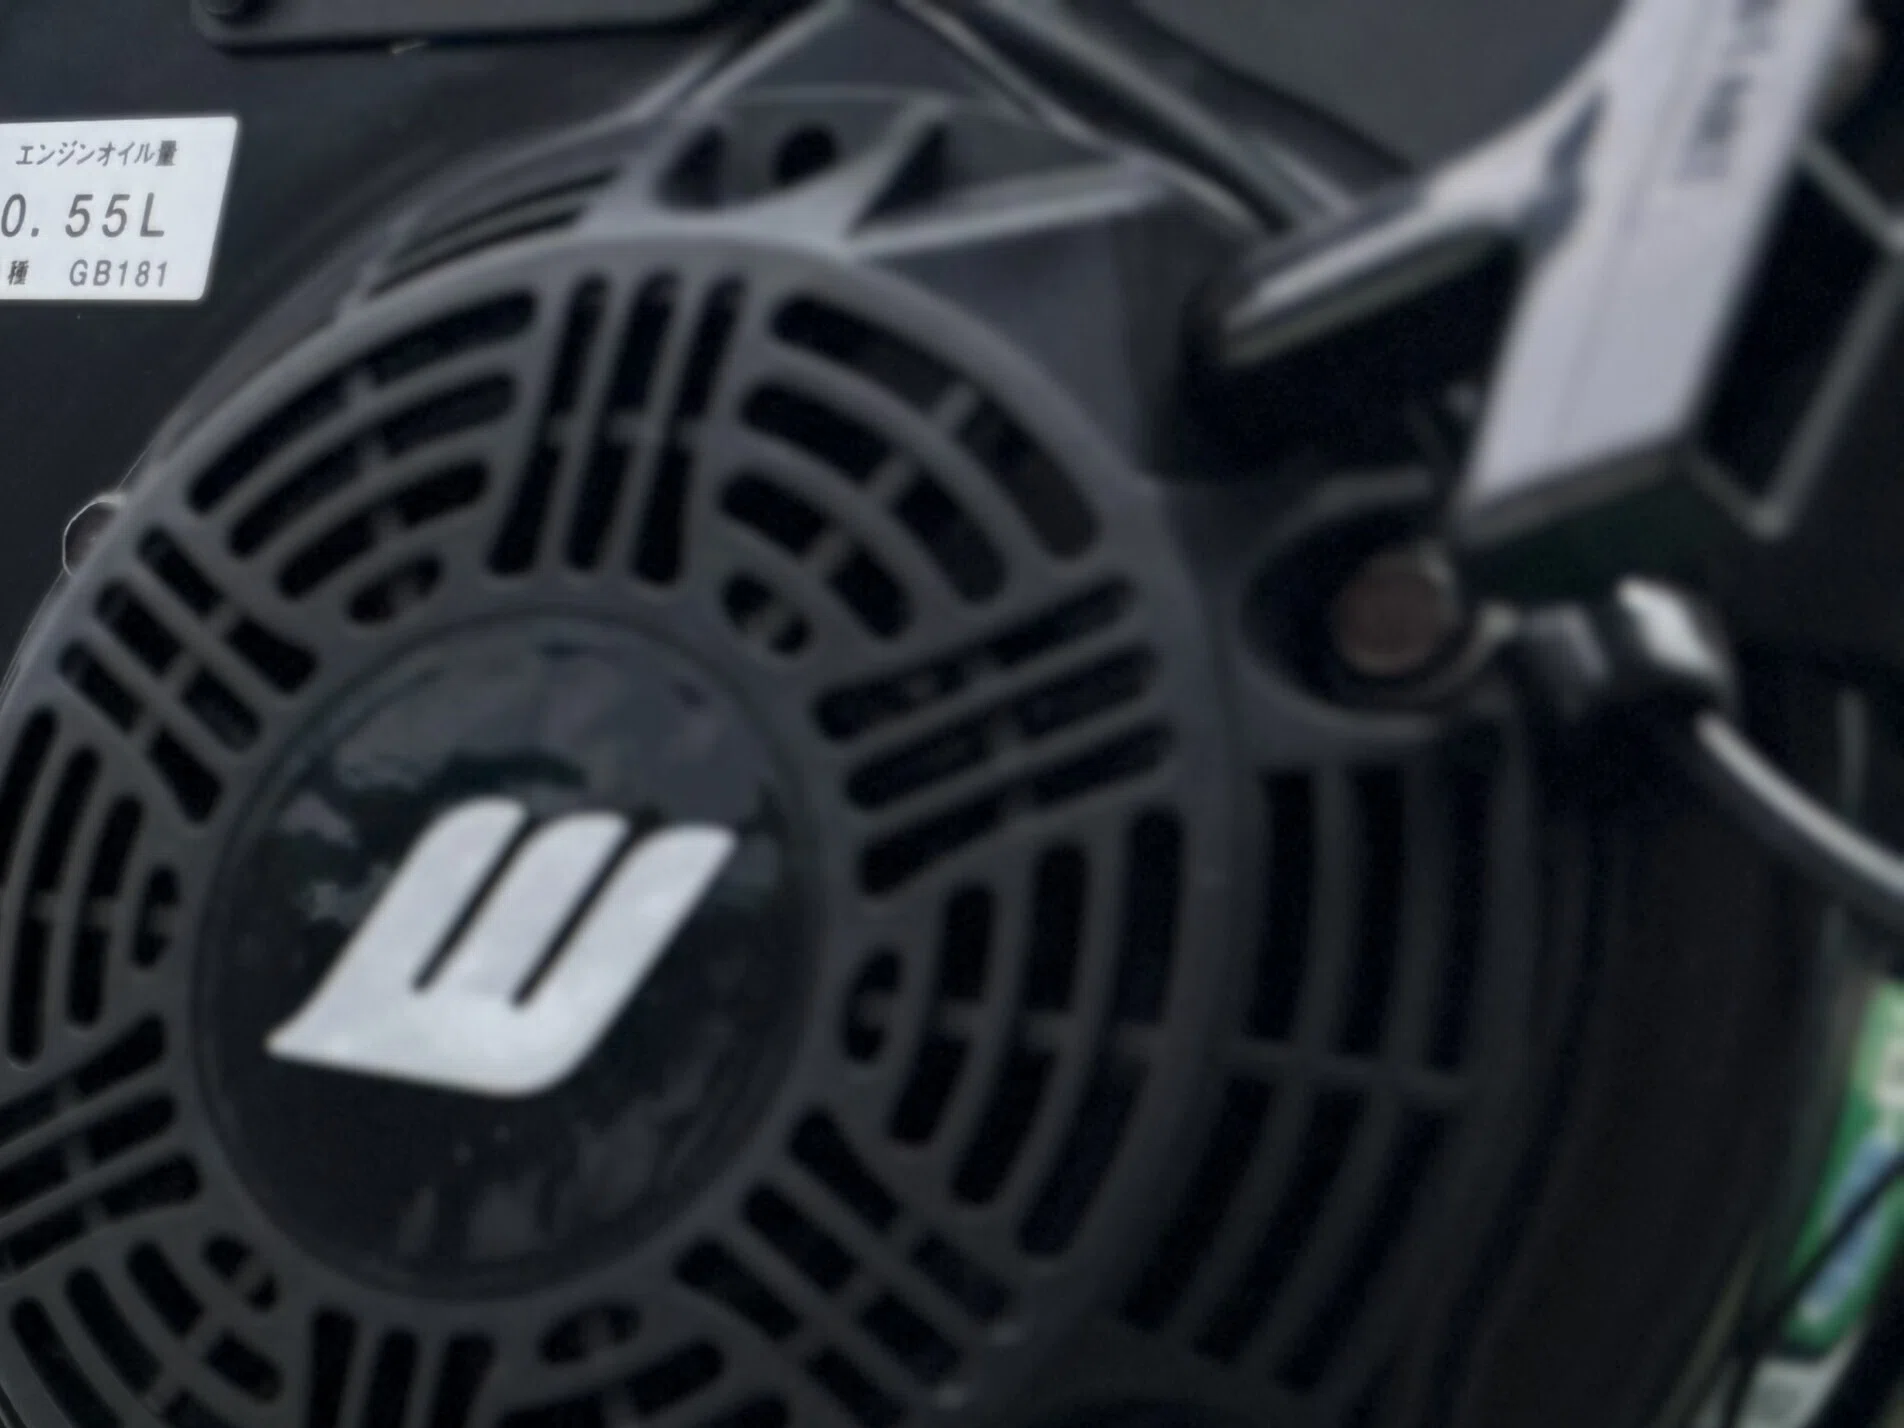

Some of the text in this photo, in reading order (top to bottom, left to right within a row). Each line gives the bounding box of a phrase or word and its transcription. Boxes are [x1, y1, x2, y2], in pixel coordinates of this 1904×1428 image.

[15, 140, 178, 167] エンジンオイル量
[68, 259, 169, 288] GB181
